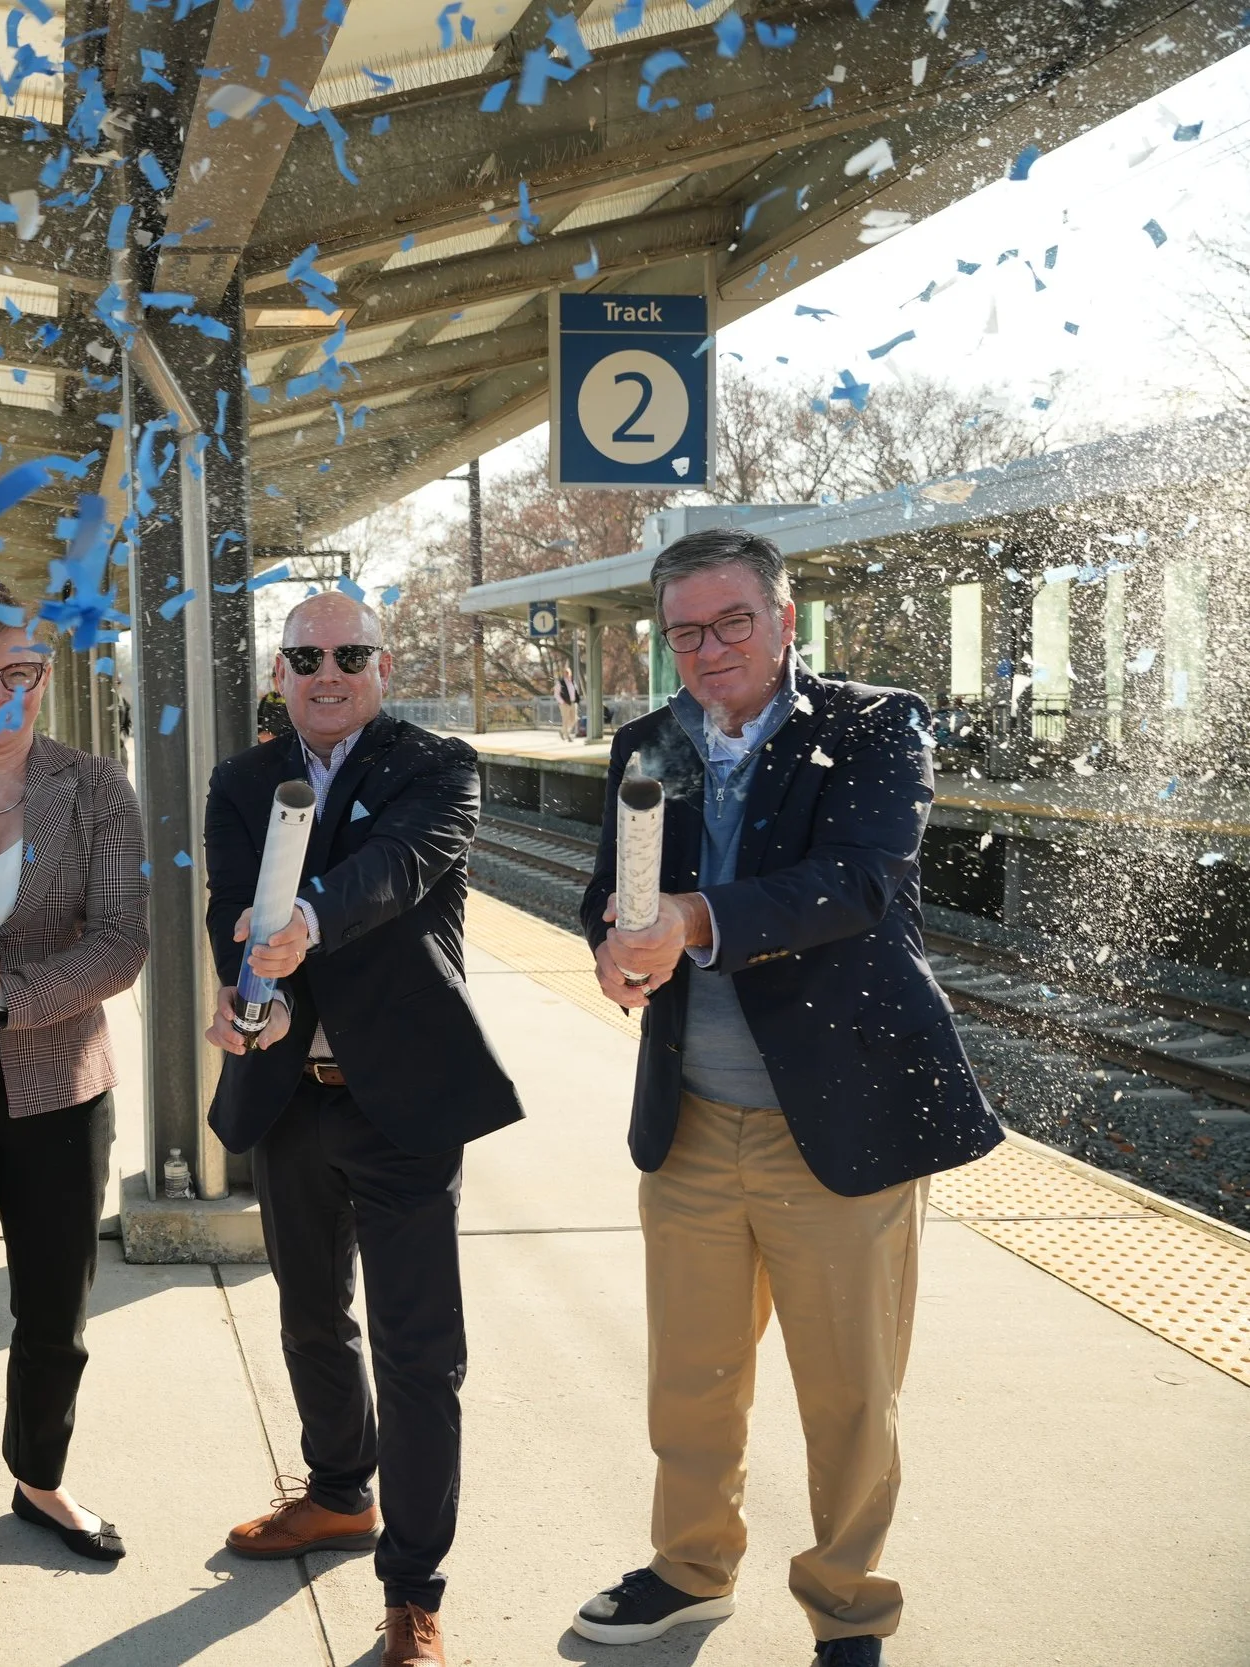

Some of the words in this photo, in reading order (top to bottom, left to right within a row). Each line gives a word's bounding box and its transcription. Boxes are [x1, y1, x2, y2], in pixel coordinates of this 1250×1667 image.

[602, 301, 663, 322] Track
[612, 371, 655, 443] 2
[539, 614, 546, 629] 1
